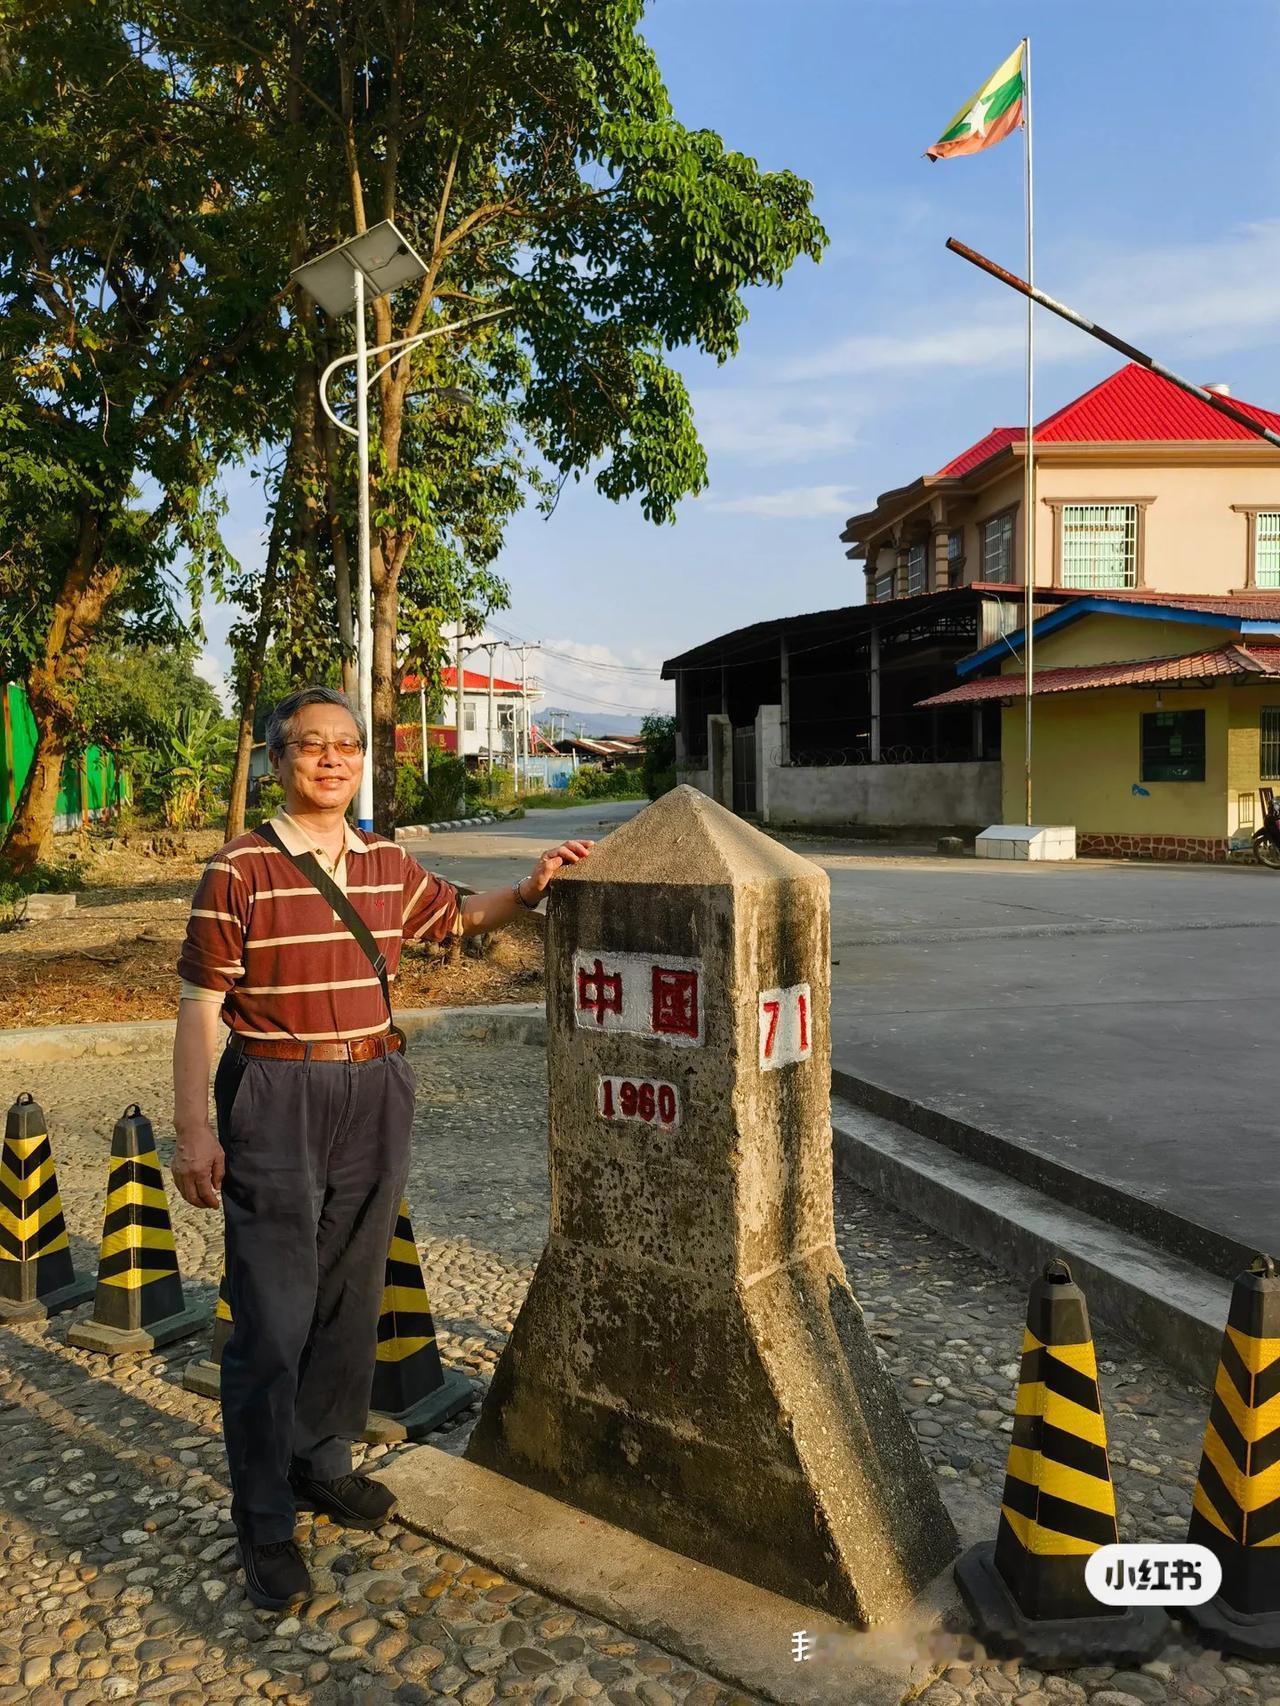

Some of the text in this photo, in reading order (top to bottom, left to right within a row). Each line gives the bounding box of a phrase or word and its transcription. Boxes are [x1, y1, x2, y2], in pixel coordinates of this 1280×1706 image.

[578, 958, 699, 1039] 中國
[763, 994, 808, 1059] 71
[601, 1079, 677, 1124] 1960
